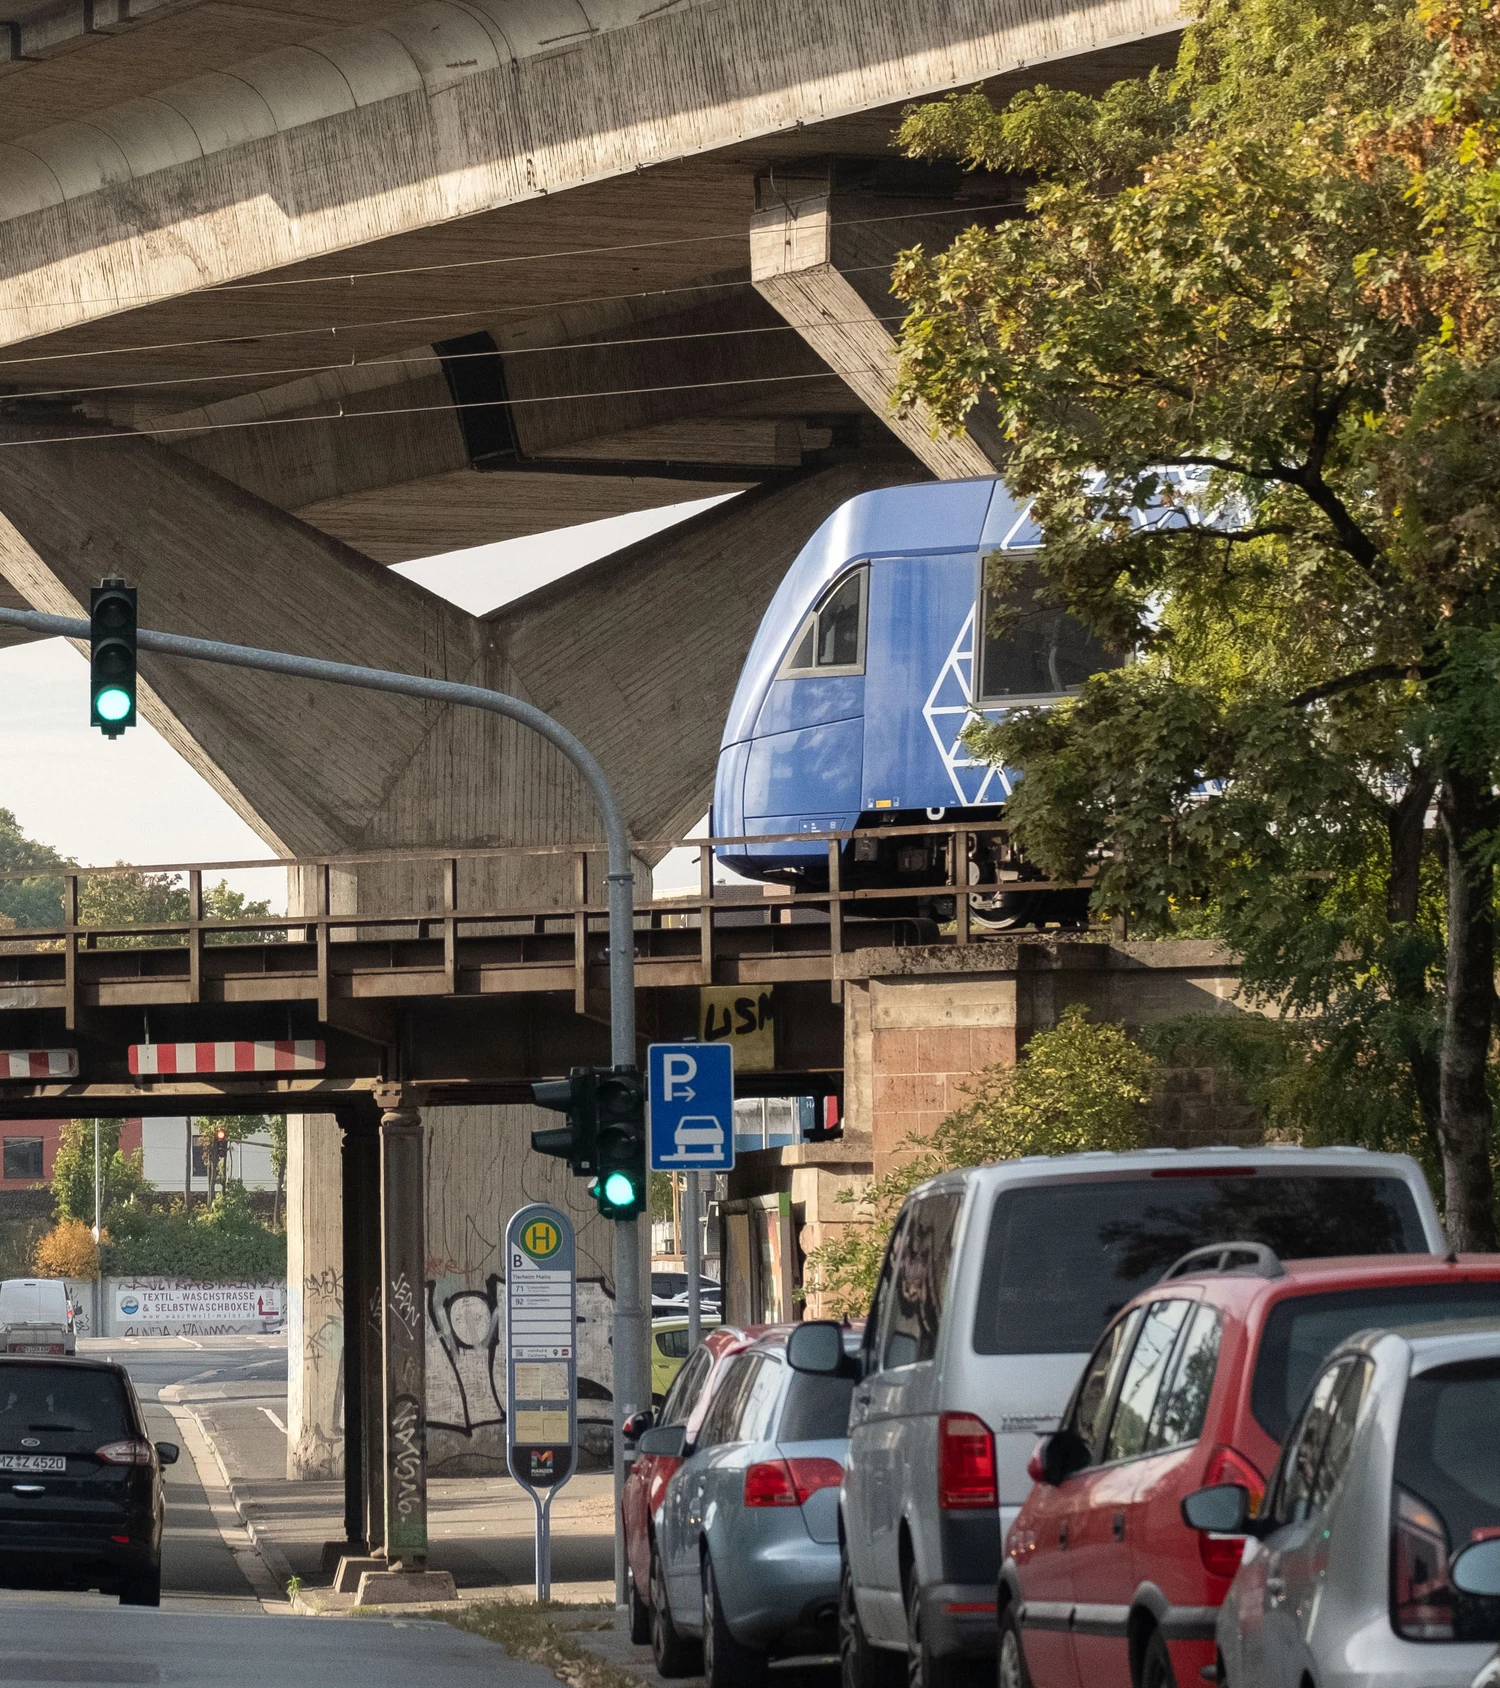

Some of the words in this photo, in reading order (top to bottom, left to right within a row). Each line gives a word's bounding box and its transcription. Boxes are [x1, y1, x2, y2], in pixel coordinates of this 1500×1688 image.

[663, 1053, 697, 1102] P
[513, 1254, 523, 1268] B
[516, 1285, 524, 1293] 71
[142, 1292, 175, 1301] TEXTIL
[181, 1291, 255, 1301] WASCHSTRASSE
[142, 1303, 150, 1312] &
[155, 1302, 256, 1312] SELBSTWASCHBOXEN
[515, 1298, 524, 1306] 92
[22, 1456, 30, 1468] Z
[33, 1457, 64, 1469] 4520
